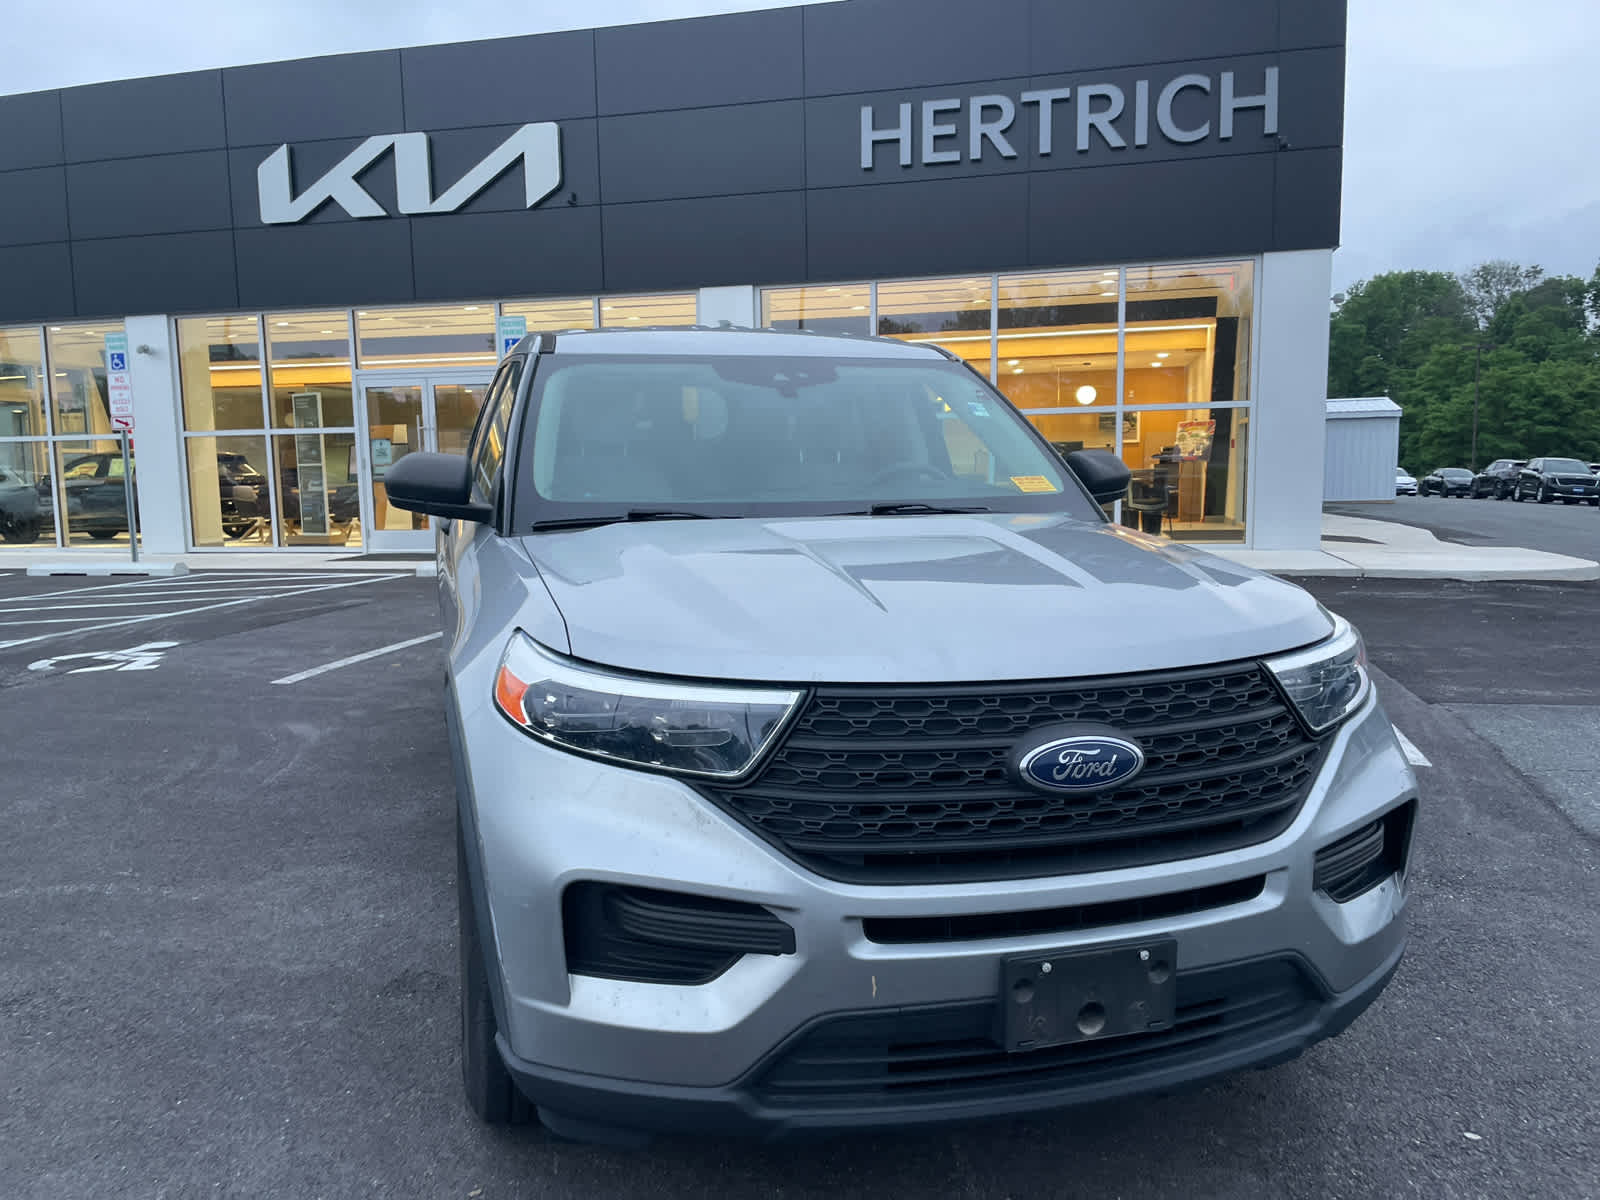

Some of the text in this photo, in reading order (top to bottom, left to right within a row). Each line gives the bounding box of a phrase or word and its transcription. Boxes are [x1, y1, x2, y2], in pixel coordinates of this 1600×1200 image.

[860, 66, 1280, 169] HERTRICH
[257, 121, 561, 224] KIA
[1052, 748, 1118, 781] Ford
